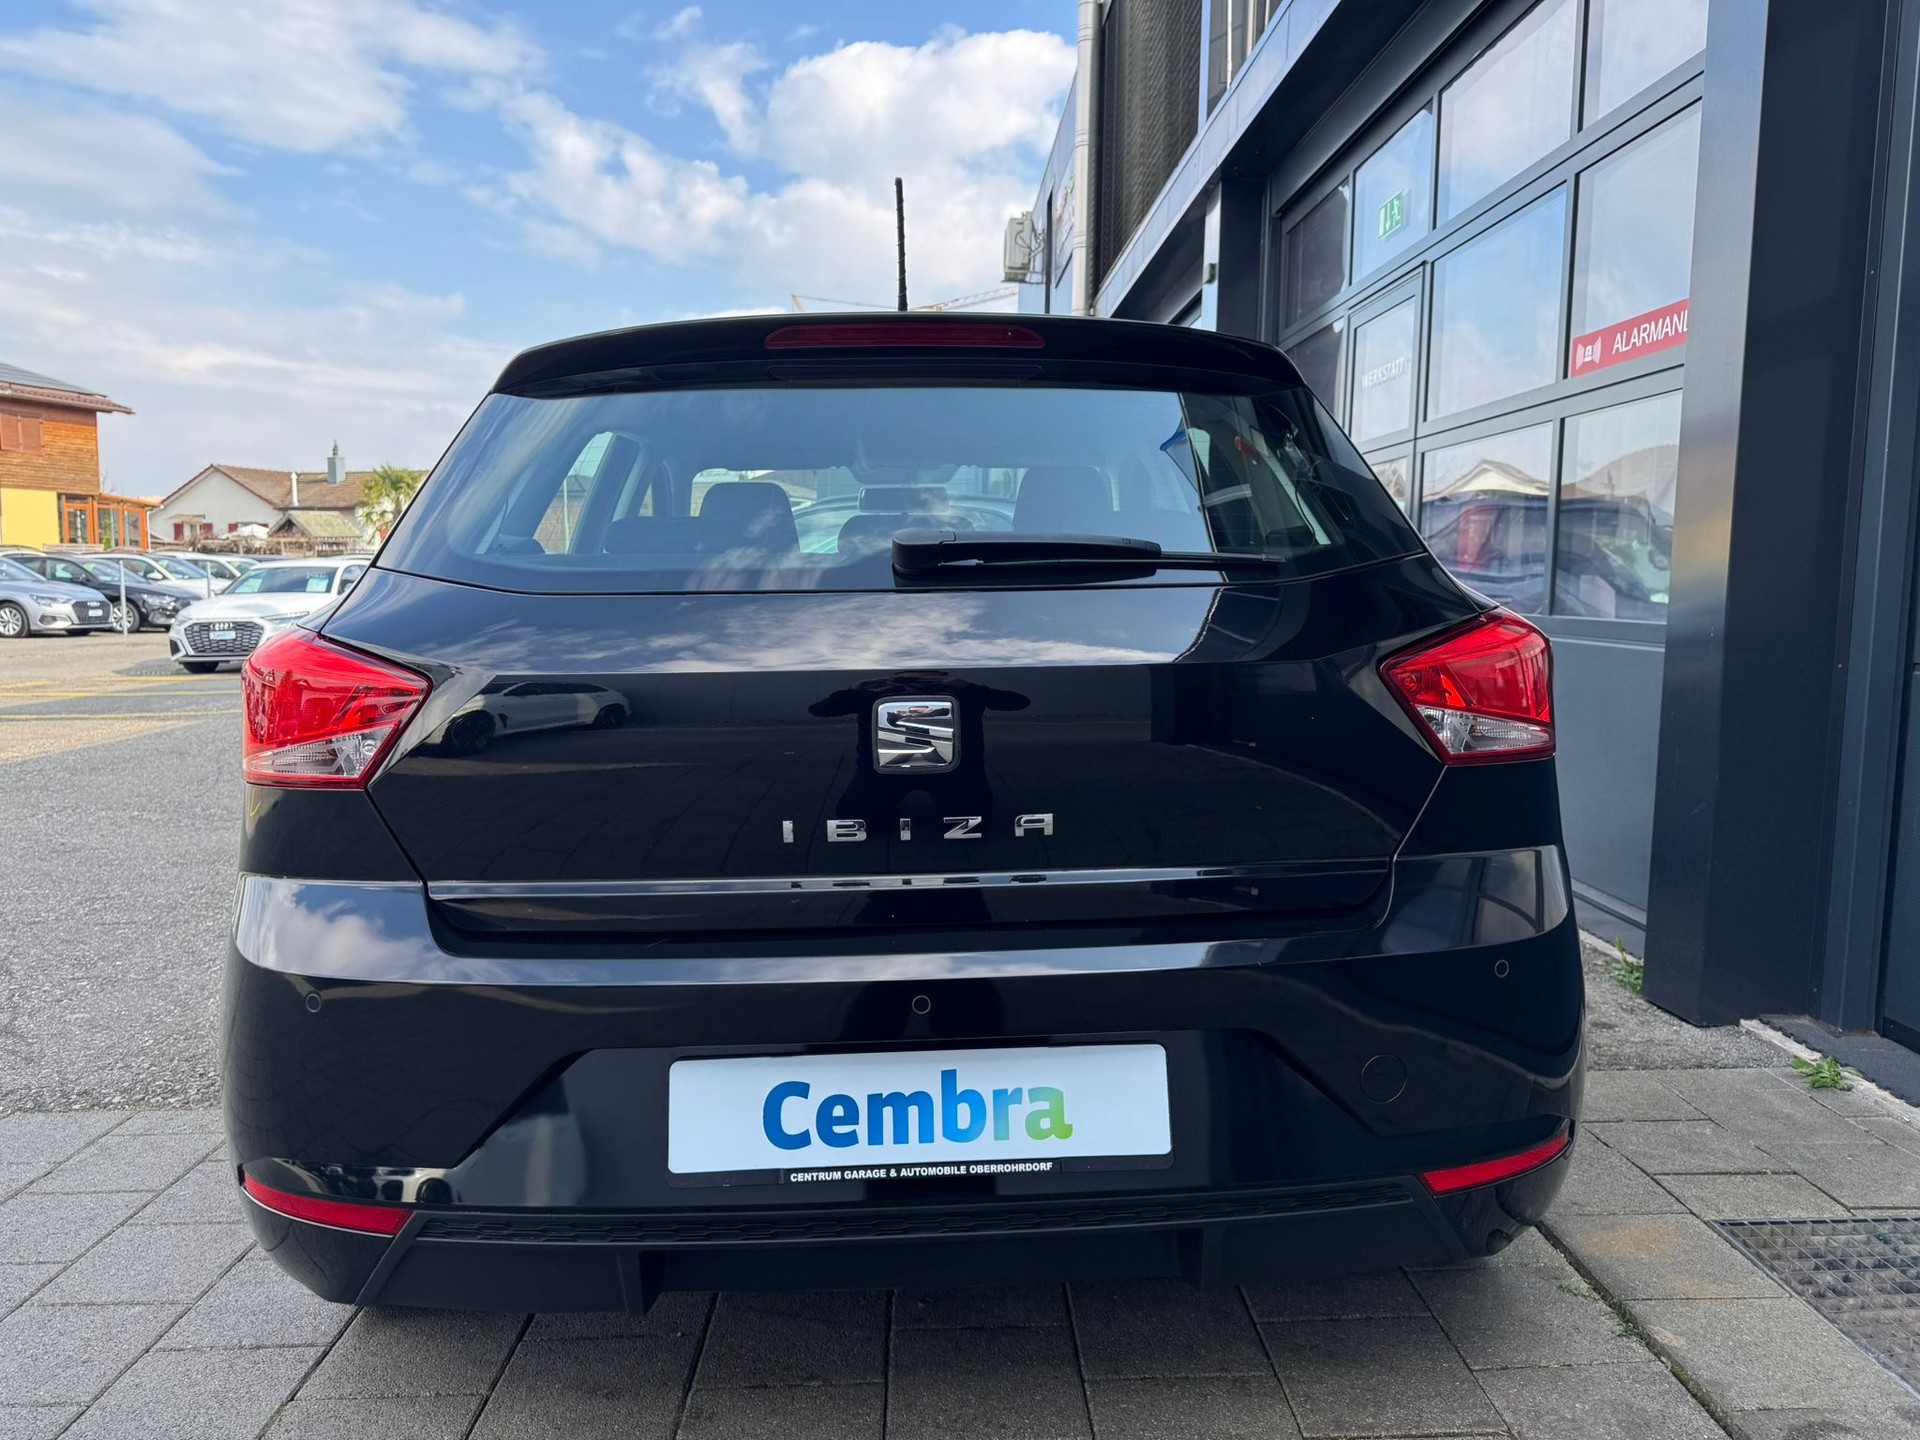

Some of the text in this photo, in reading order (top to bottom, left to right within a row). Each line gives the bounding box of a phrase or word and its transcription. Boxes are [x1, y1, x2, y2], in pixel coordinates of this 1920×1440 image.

[782, 813, 1054, 844] IBIZA
[762, 1069, 1073, 1150] Cembra
[790, 1162, 1053, 1182] CENTRUM GARAGE & AUTOMOBILE OBERROHRDORF
